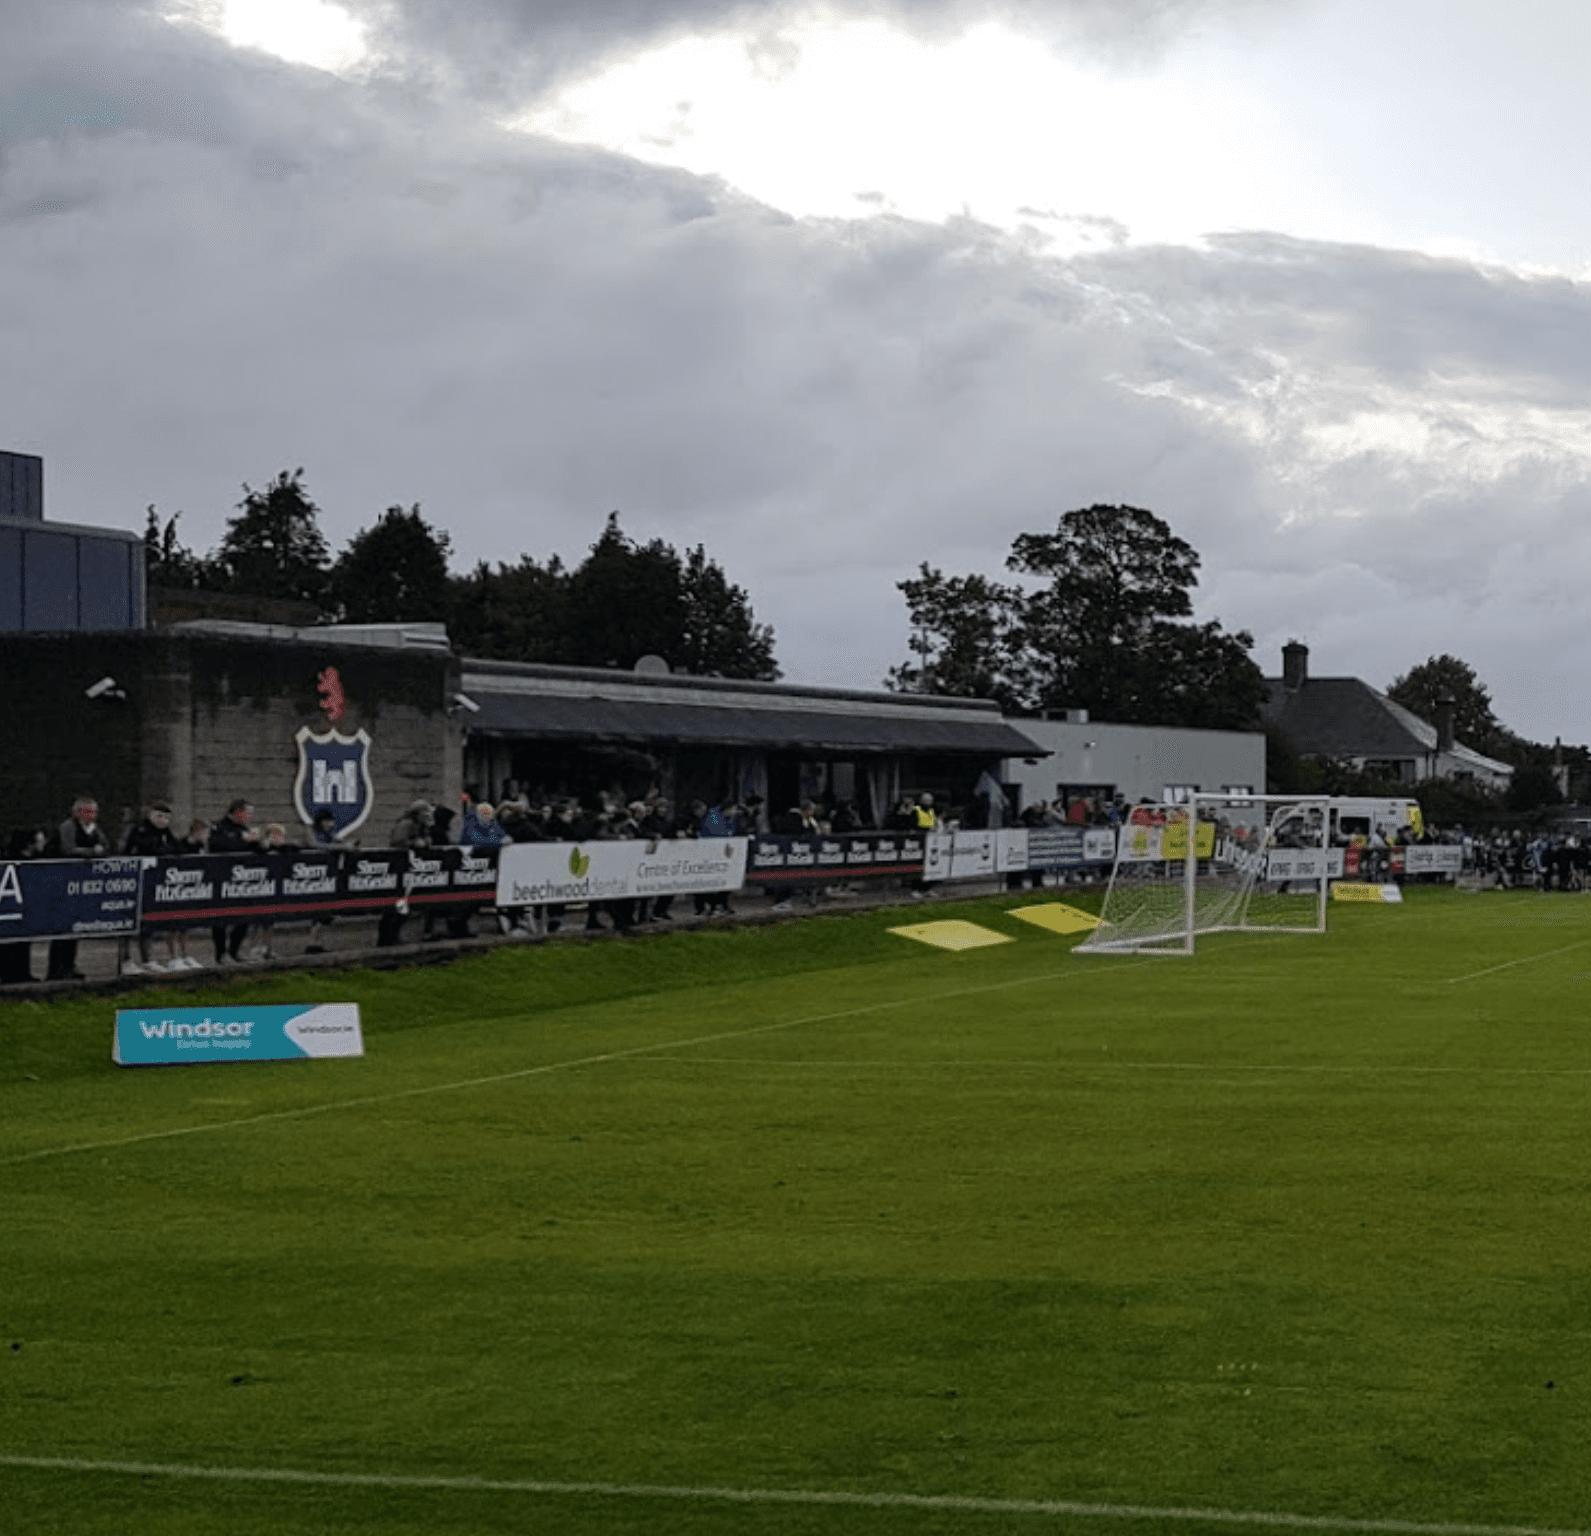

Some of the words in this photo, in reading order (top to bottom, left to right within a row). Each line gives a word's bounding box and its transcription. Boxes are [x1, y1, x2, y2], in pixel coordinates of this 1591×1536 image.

[165, 867, 204, 884] Sherry
[231, 865, 269, 881] Sherry
[67, 881, 80, 895] 01
[139, 1017, 254, 1039] Windsor
